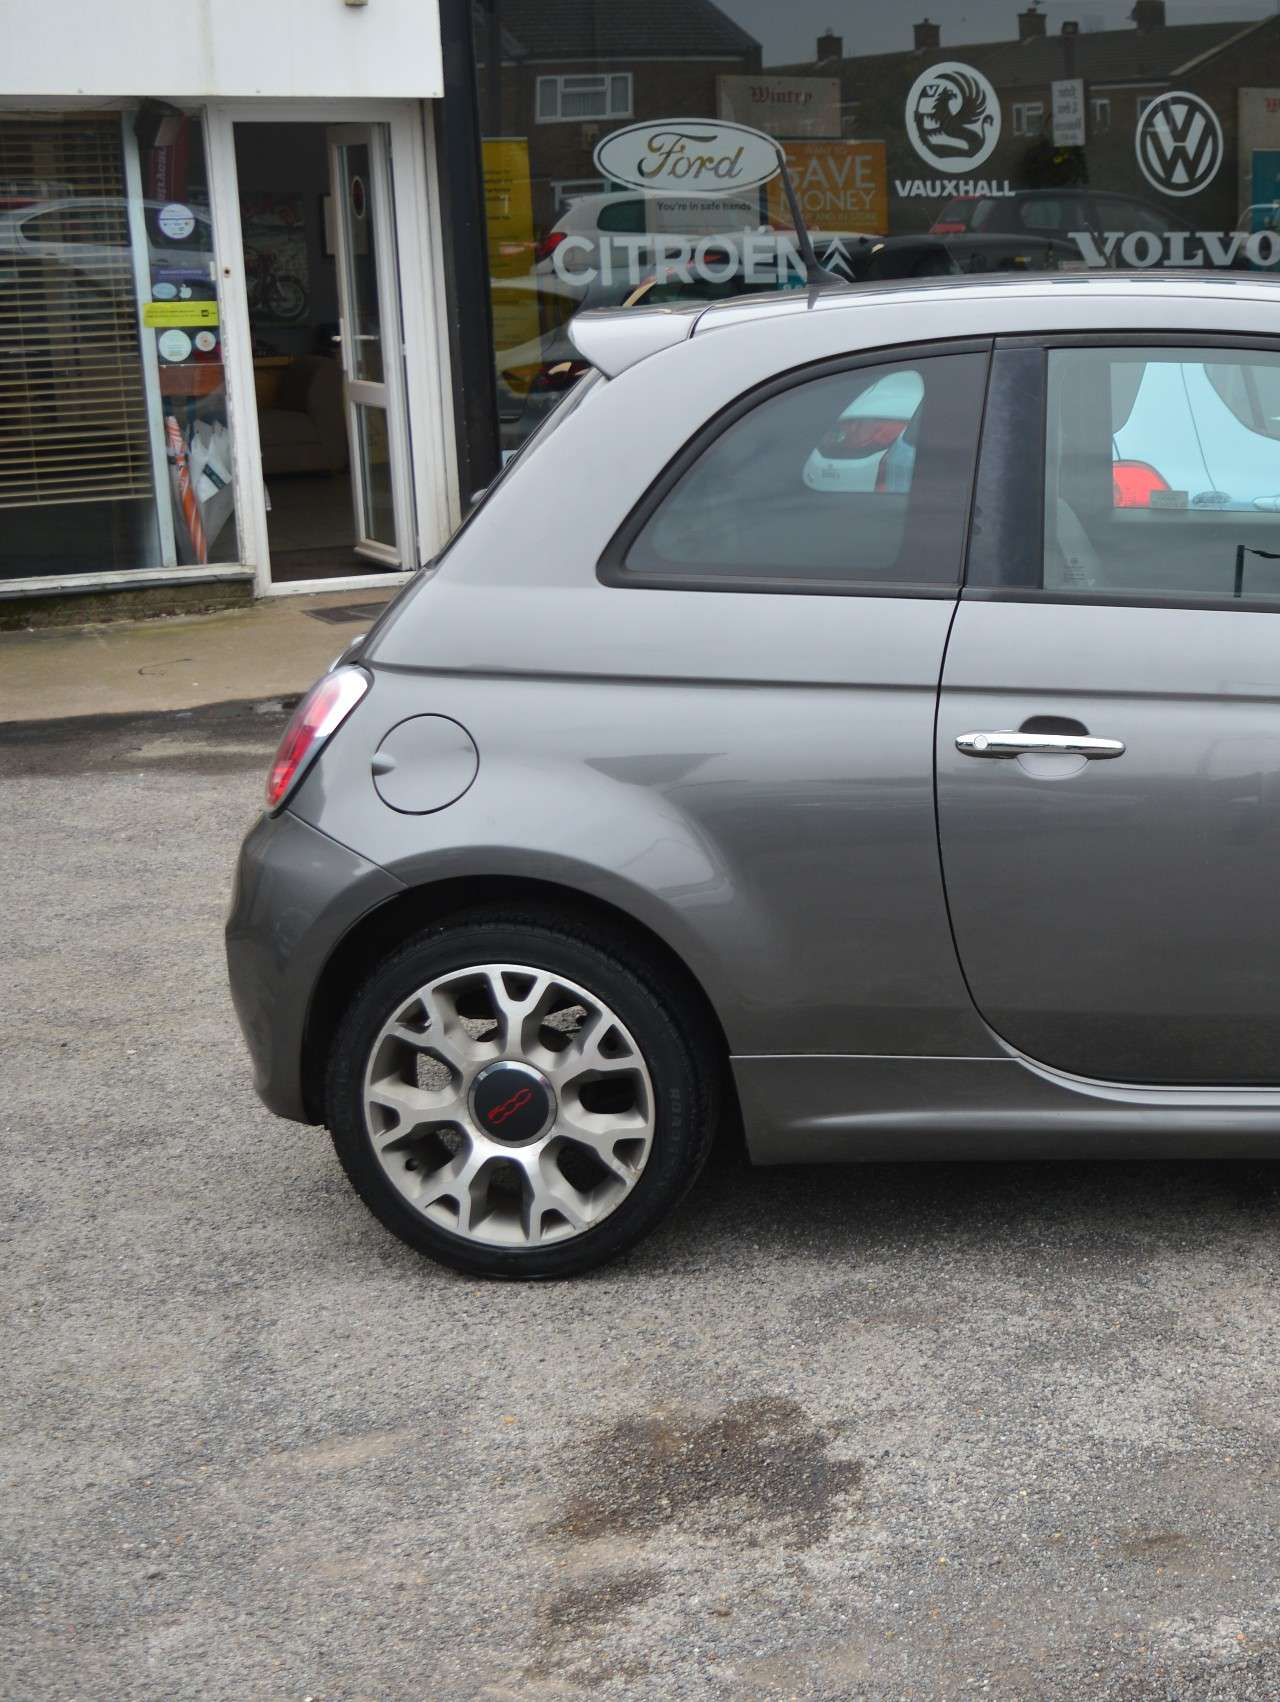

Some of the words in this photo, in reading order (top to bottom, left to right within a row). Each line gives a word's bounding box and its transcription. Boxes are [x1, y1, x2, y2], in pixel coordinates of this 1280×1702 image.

[637, 132, 745, 179] Ford
[779, 154, 875, 189] SAVE
[895, 178, 1016, 198] VAUXHALL
